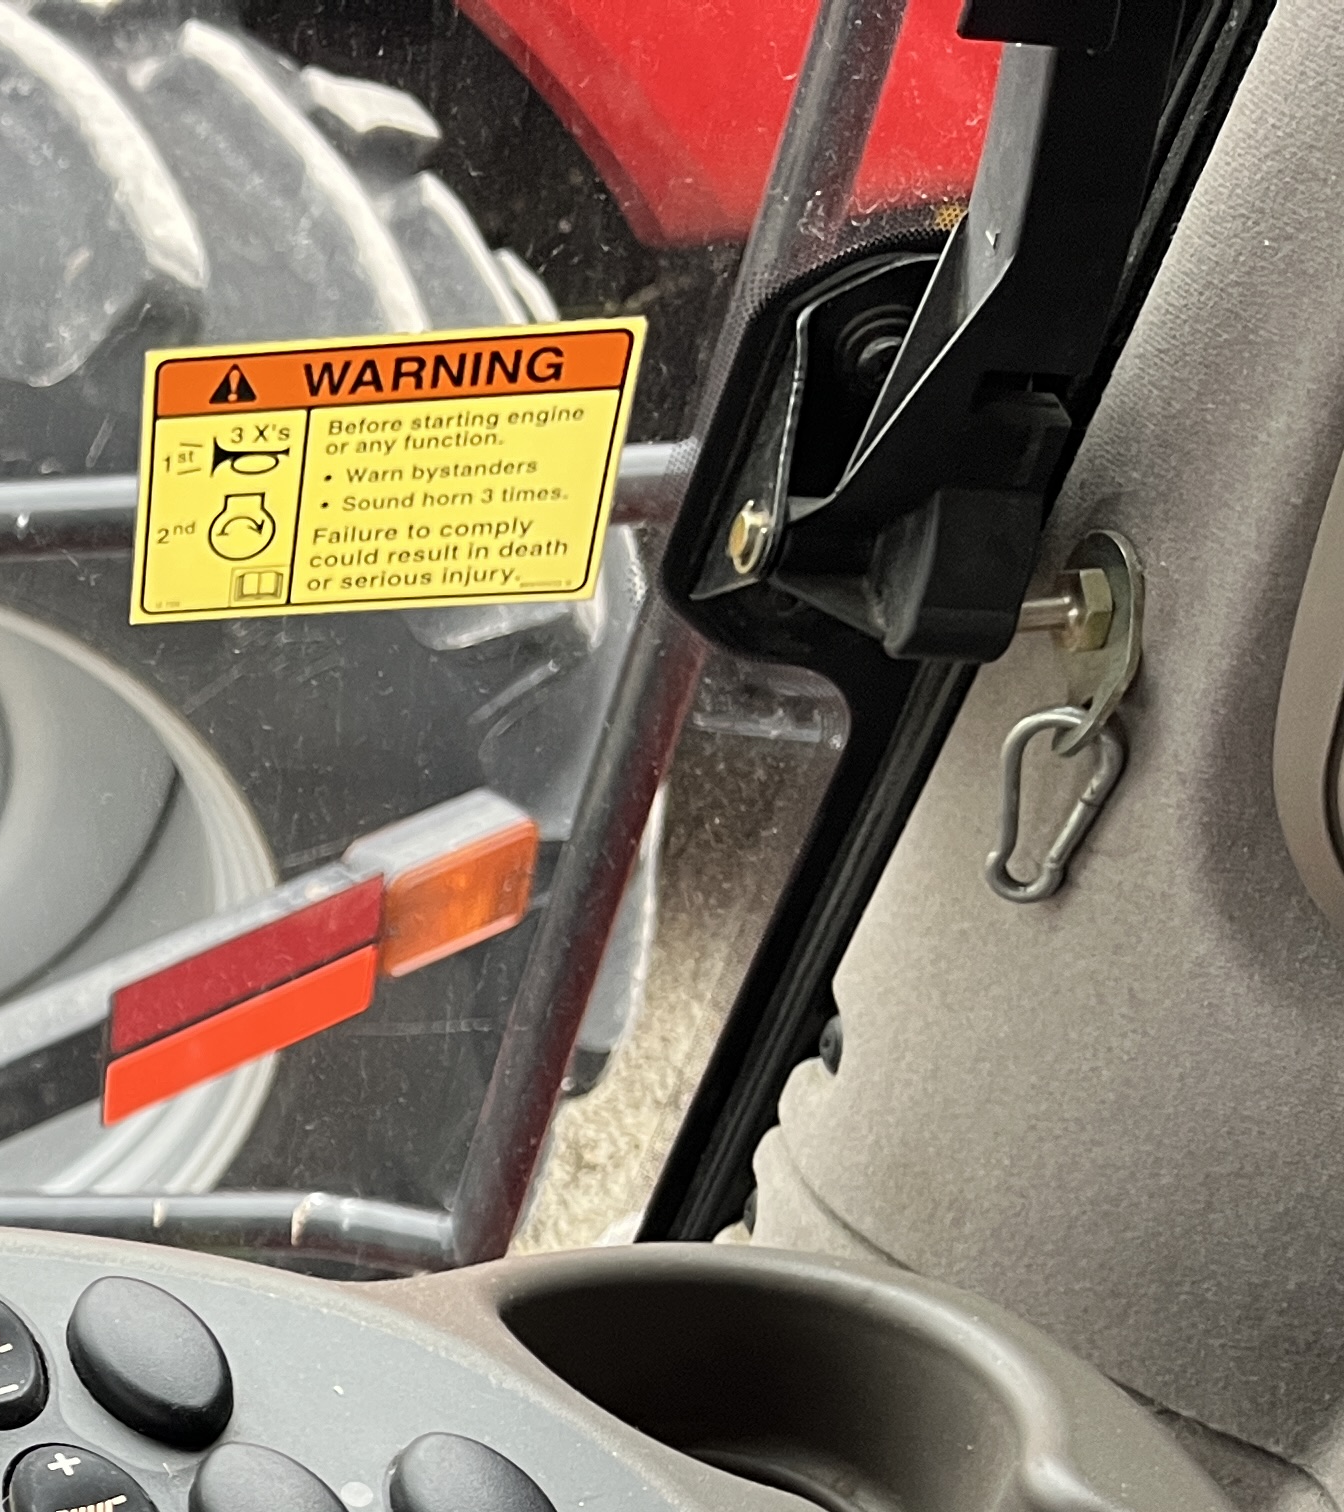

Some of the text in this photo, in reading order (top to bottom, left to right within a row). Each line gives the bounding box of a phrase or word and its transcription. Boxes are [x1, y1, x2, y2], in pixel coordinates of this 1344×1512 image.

[303, 346, 565, 397] WARNING
[327, 406, 585, 436] Before starting engine
[231, 425, 291, 444] 3 X's
[325, 430, 505, 456] or any function.
[346, 459, 539, 484] Warn bystanders
[342, 485, 569, 512] Sound horn 3 times.
[157, 522, 196, 544] 2nd
[312, 517, 534, 545] Failure to comply
[310, 539, 569, 568] could result in death
[307, 576, 333, 592] or
[340, 569, 433, 590] serious
[441, 566, 521, 587] injury.
